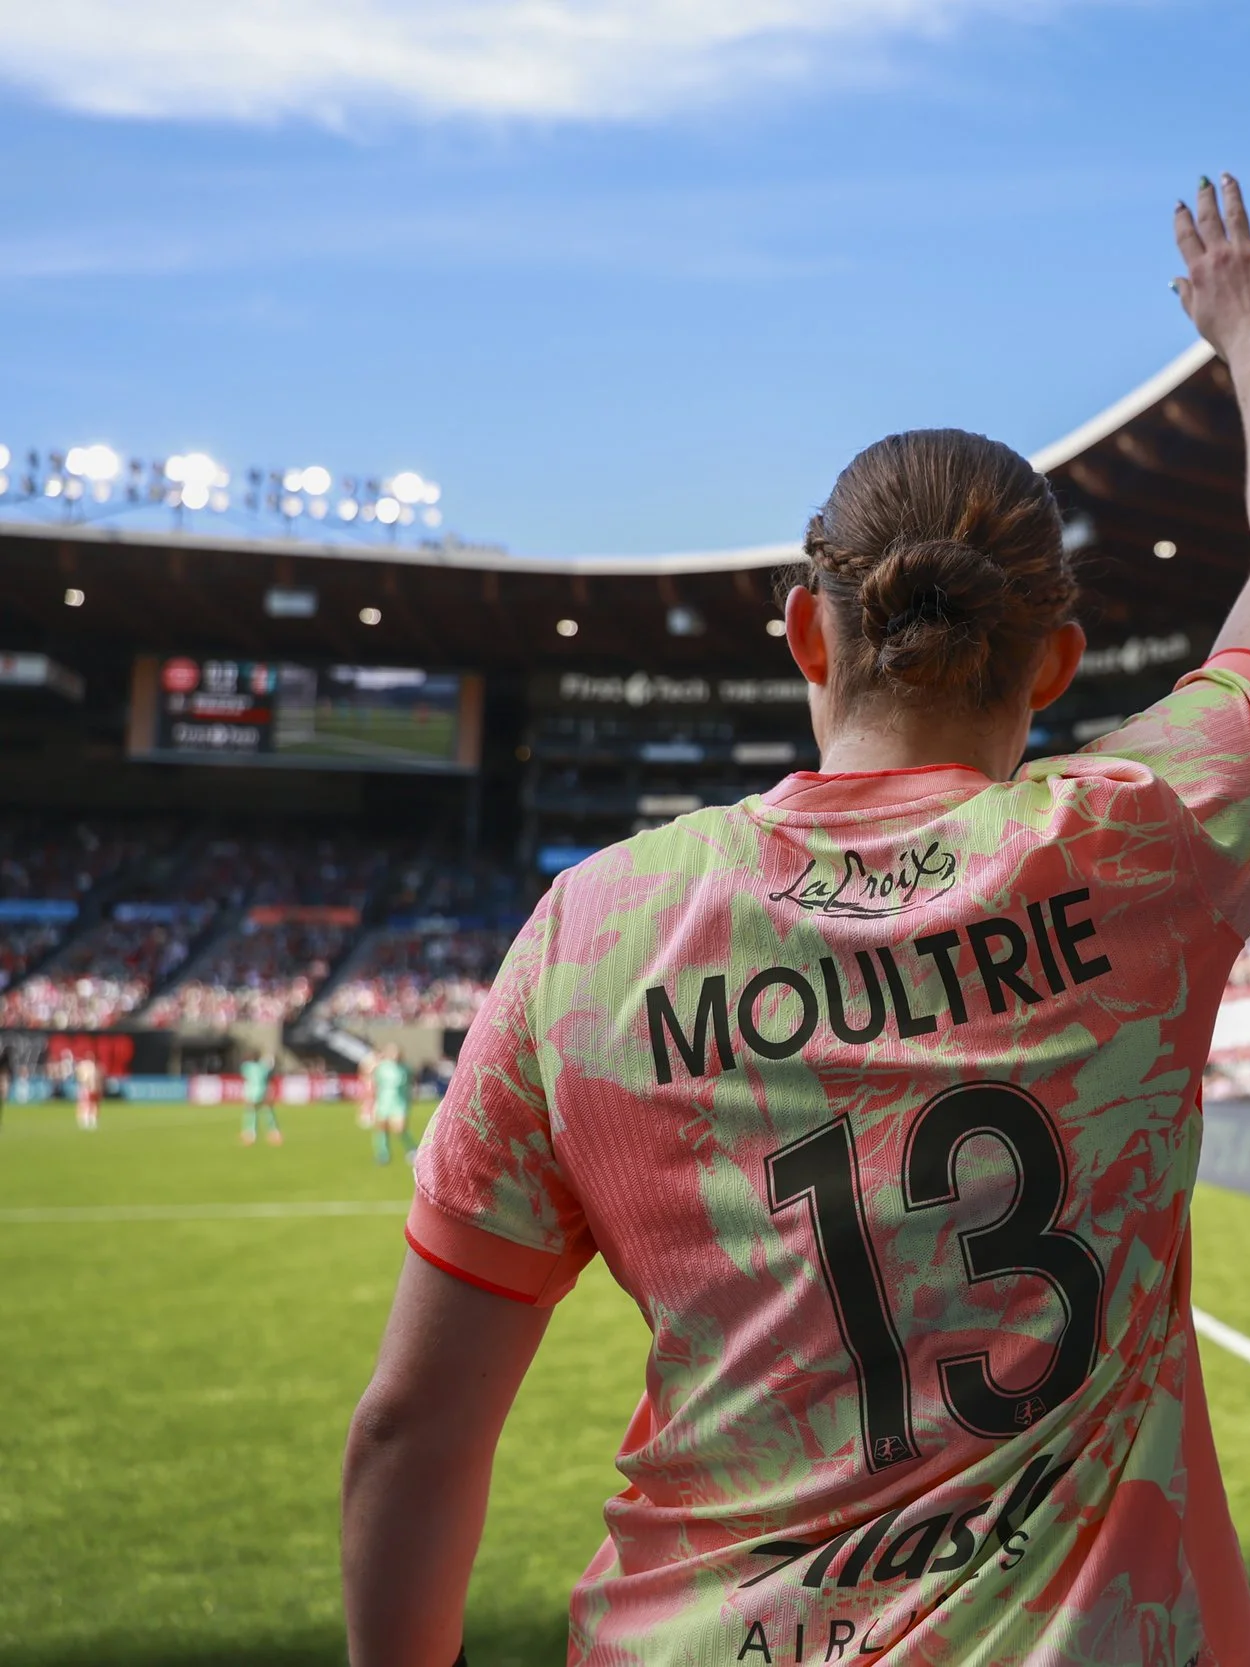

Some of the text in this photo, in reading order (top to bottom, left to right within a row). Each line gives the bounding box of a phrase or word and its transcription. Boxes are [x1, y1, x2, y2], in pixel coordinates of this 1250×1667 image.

[646, 887, 1112, 1085] MOULTRIE
[763, 1079, 1105, 1475] 13
[737, 1453, 1078, 1588] Alask
